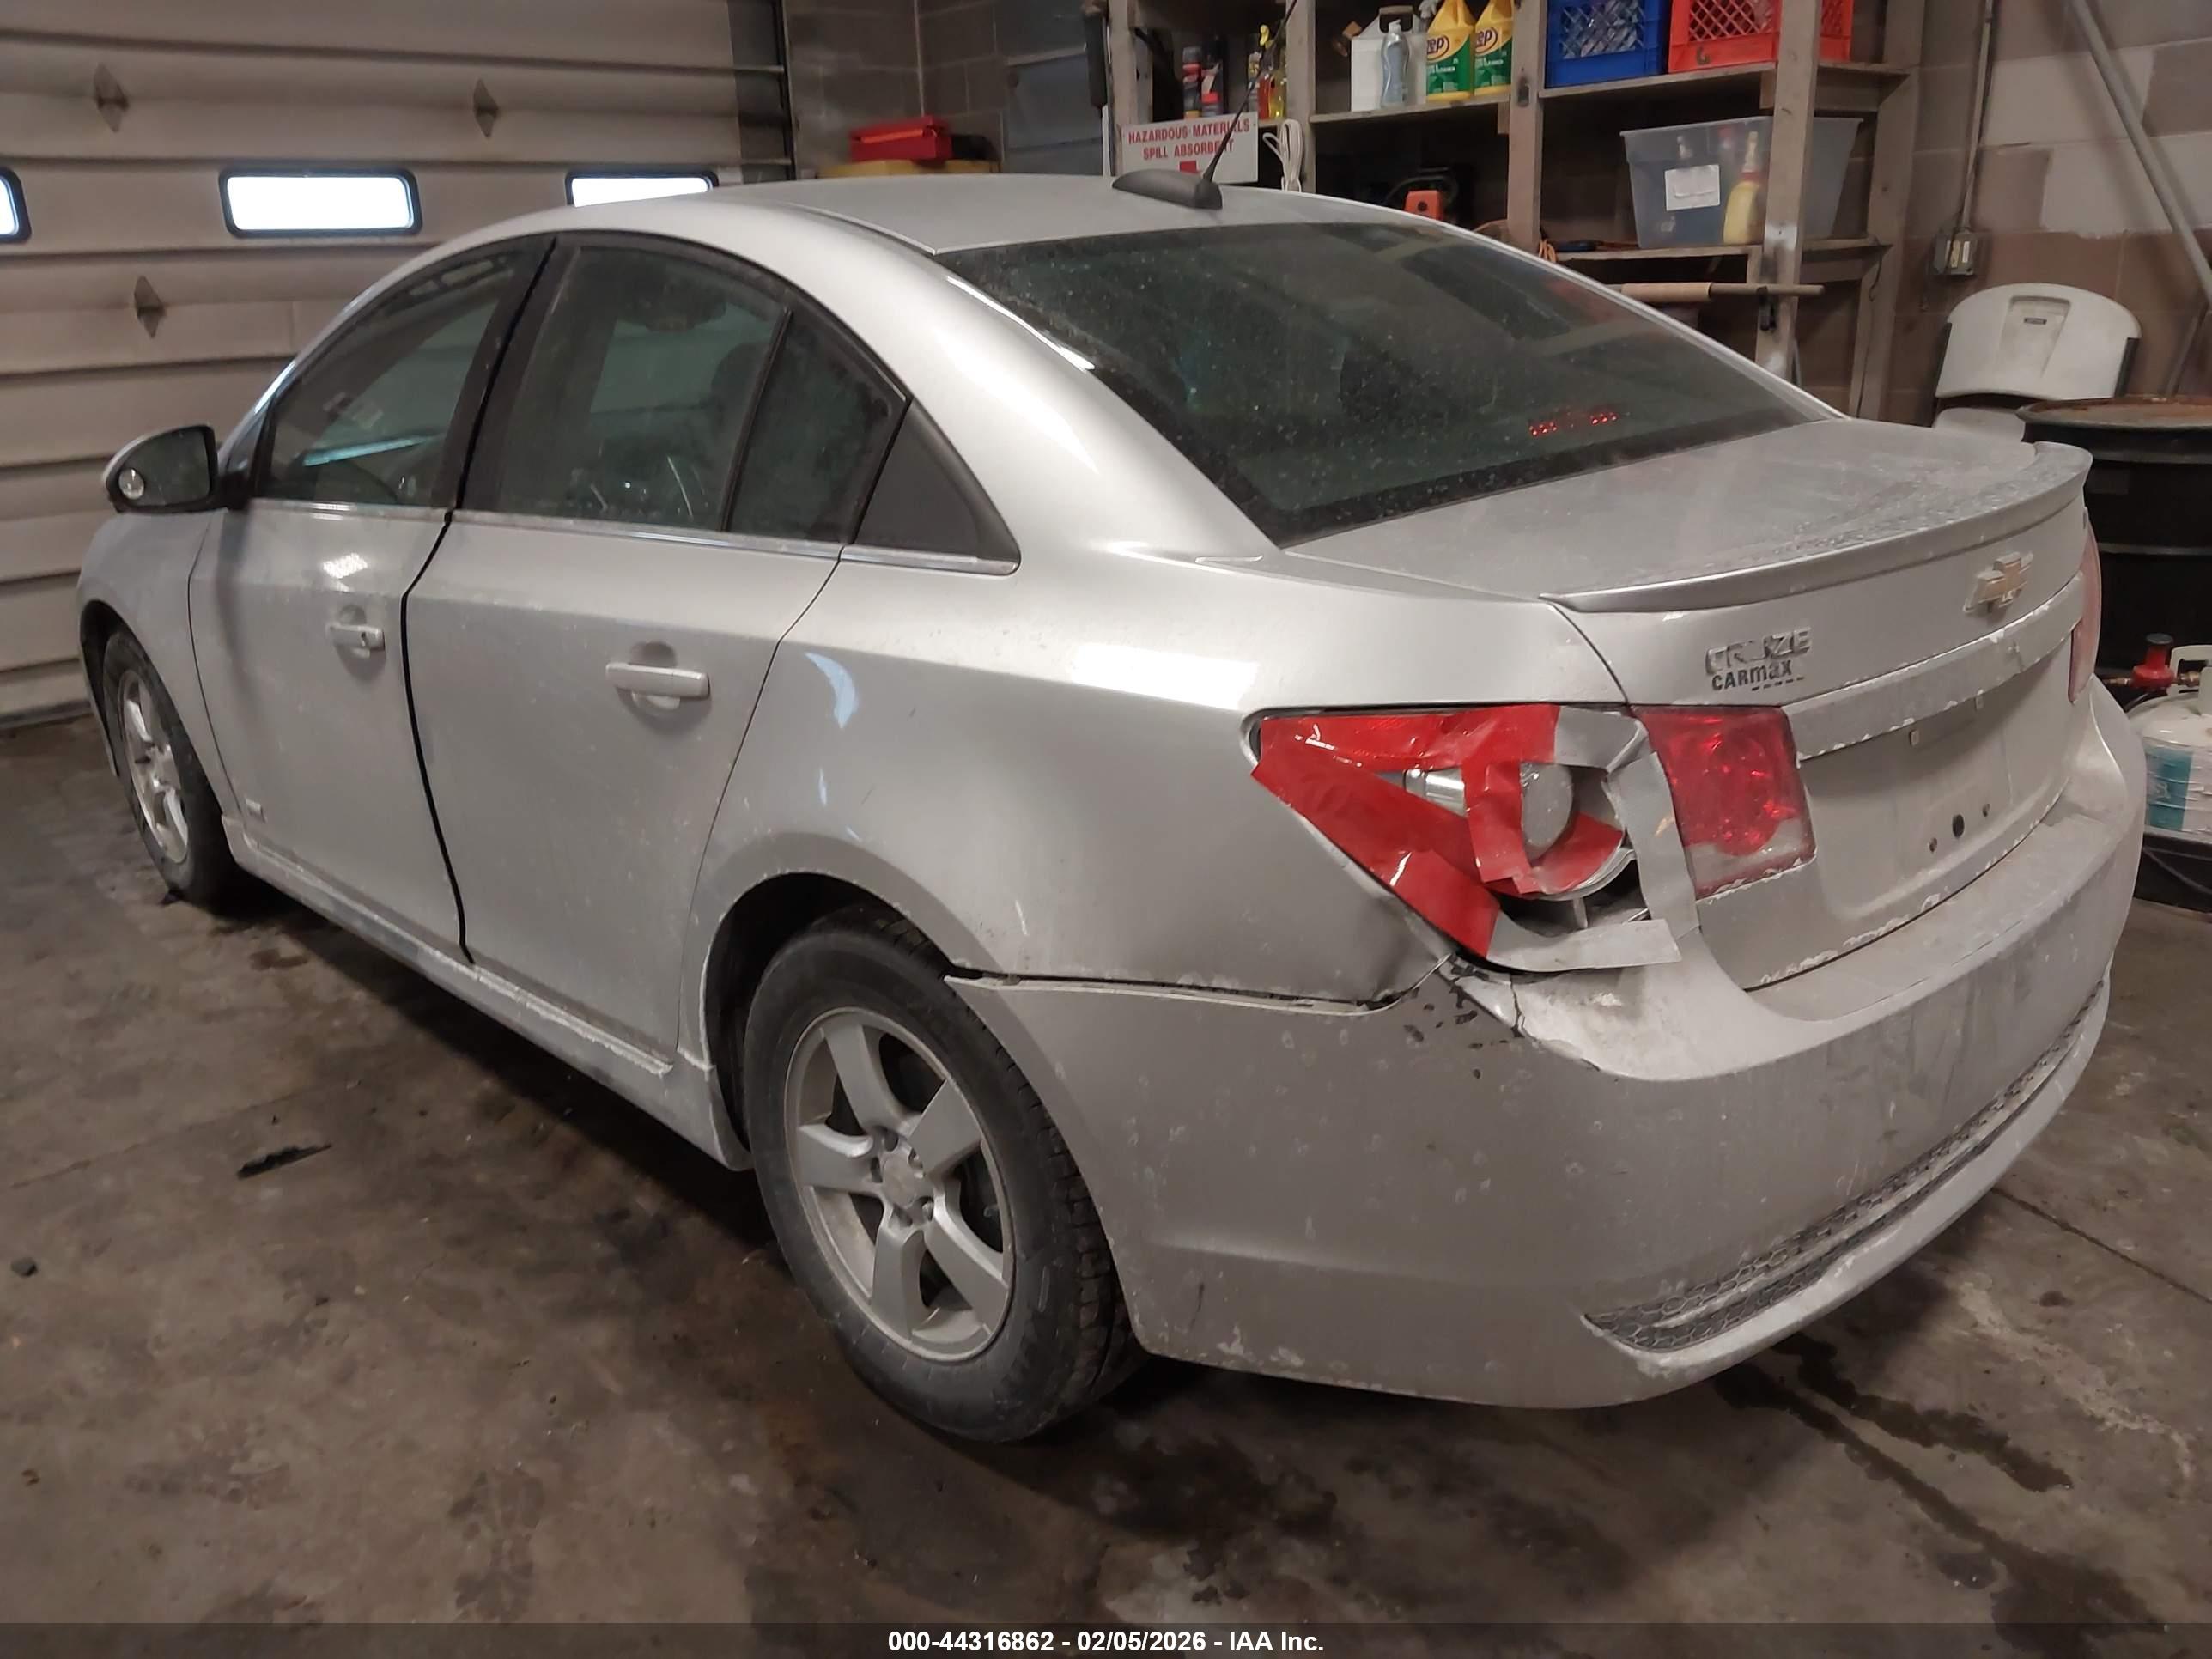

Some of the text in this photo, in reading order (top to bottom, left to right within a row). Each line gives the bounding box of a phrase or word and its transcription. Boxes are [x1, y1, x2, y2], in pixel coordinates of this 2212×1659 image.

[1128, 118, 1250, 145] HAZARDOUS MATERILS
[1143, 147, 1169, 161] SPILL
